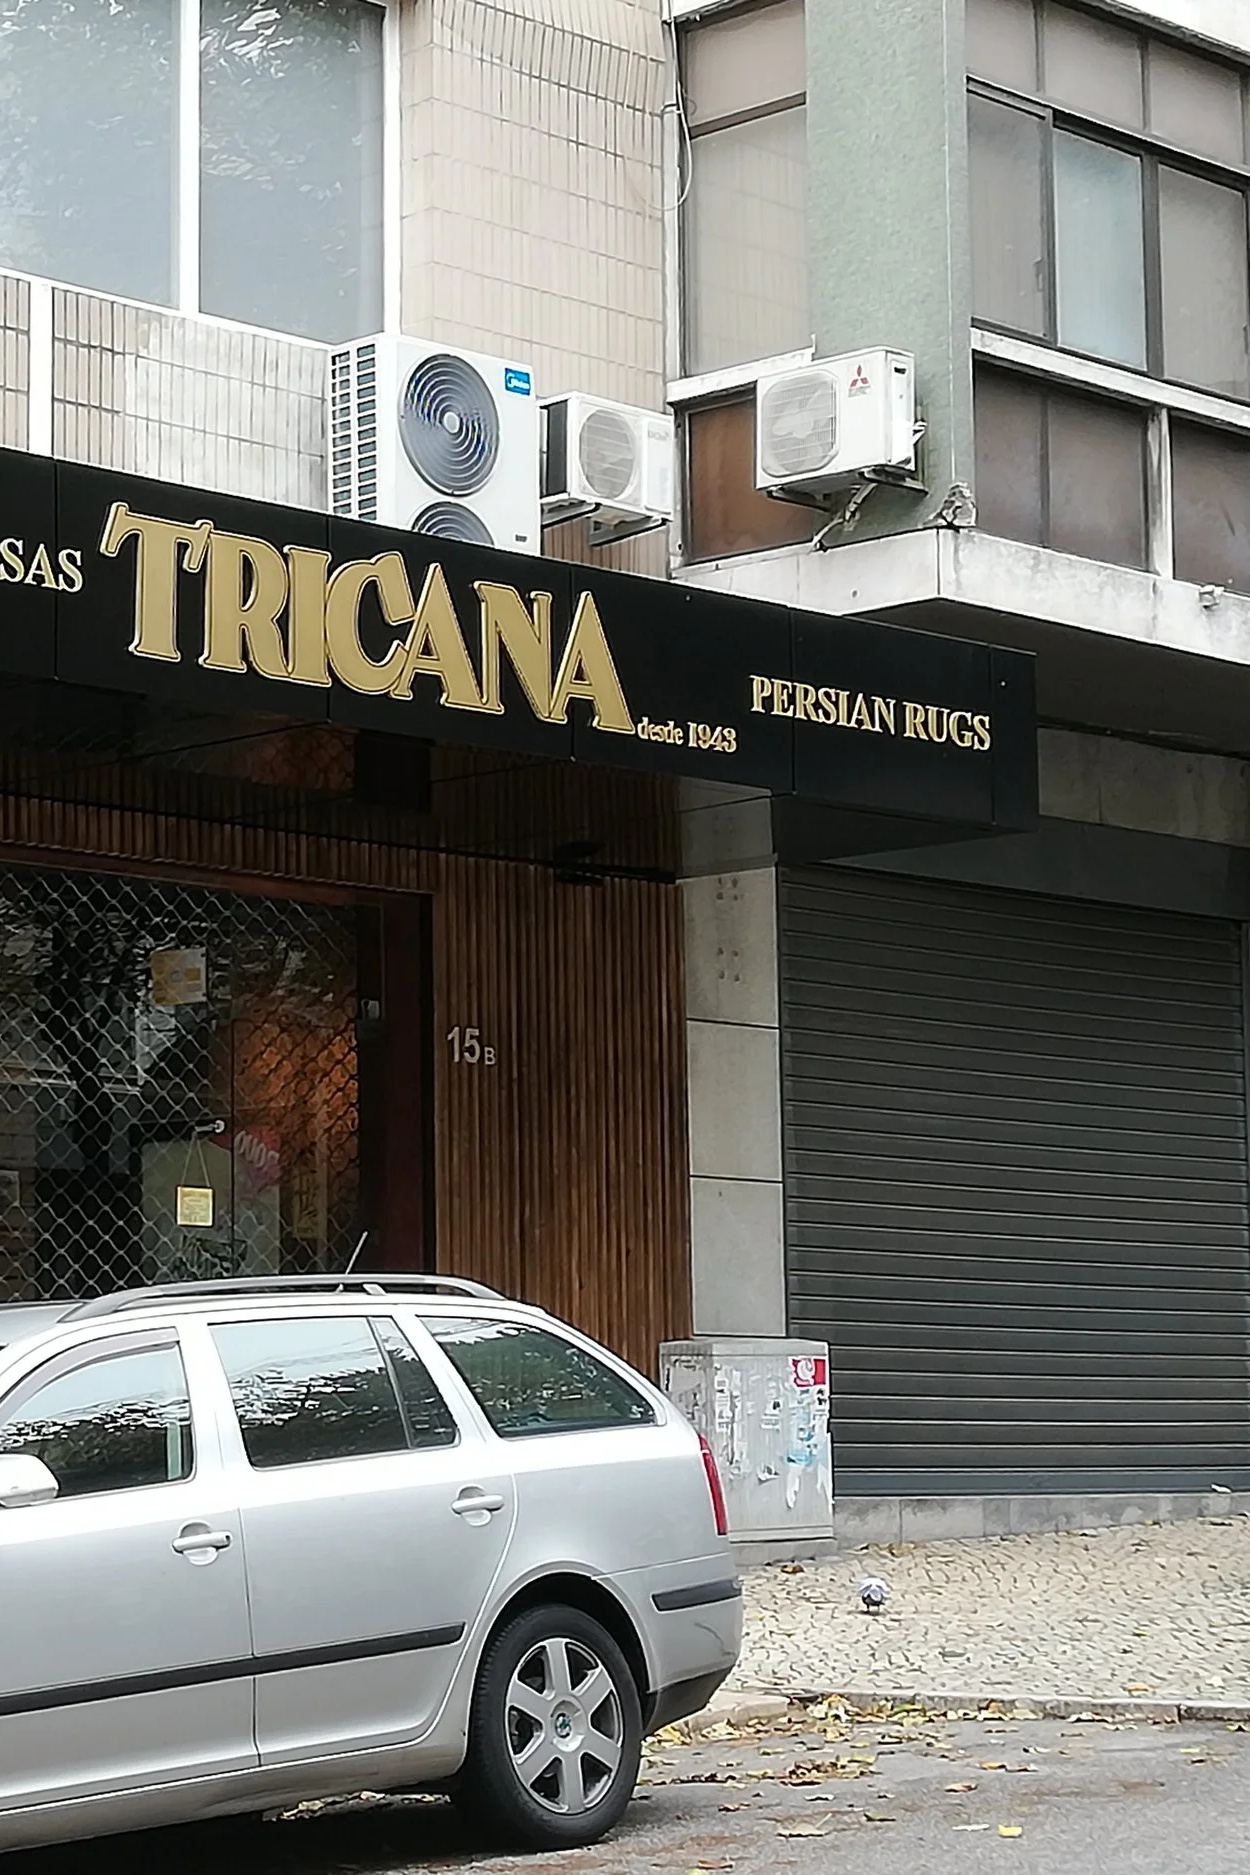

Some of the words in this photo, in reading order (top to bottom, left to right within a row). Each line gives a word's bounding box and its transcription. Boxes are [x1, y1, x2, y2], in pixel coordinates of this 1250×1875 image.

[100, 502, 635, 734] TRICANA
[637, 717, 683, 745] desde
[688, 722, 737, 753] 1943
[749, 675, 896, 735] PERSIAN
[903, 702, 991, 751] RUGS
